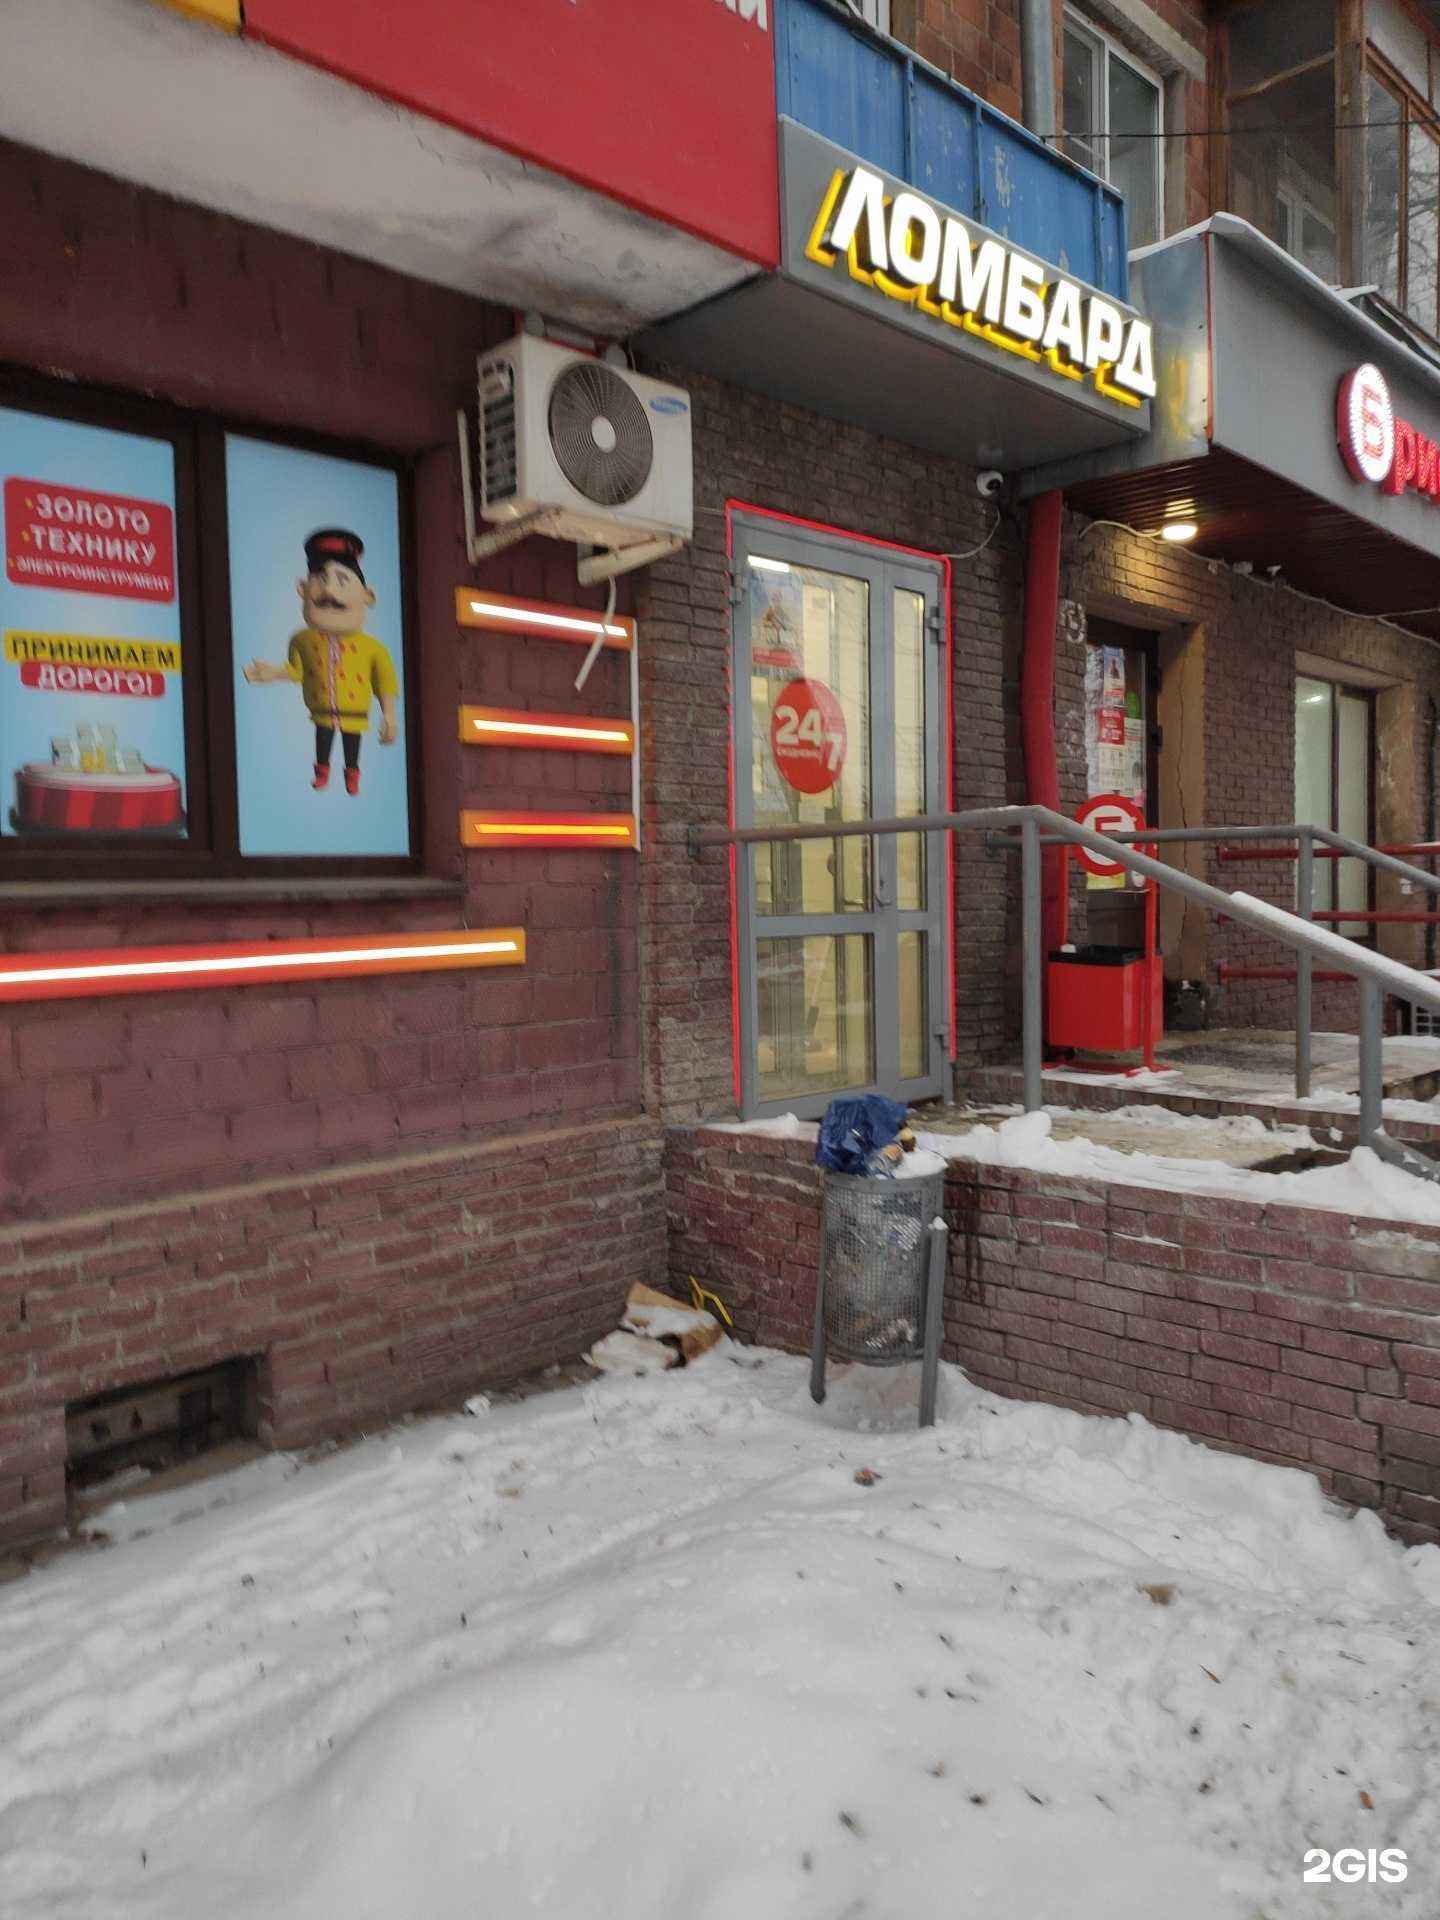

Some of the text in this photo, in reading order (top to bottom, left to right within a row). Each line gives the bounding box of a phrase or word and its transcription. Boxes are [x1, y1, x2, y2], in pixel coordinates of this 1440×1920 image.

[830, 166, 1156, 398] ЛОМБАРД
[36, 493, 150, 535] ЗОЛОТО
[30, 523, 156, 567] ТЕХНИКУ
[12, 637, 175, 668] ПРИНИМАЕМ
[38, 664, 152, 695] ДОРОГО!
